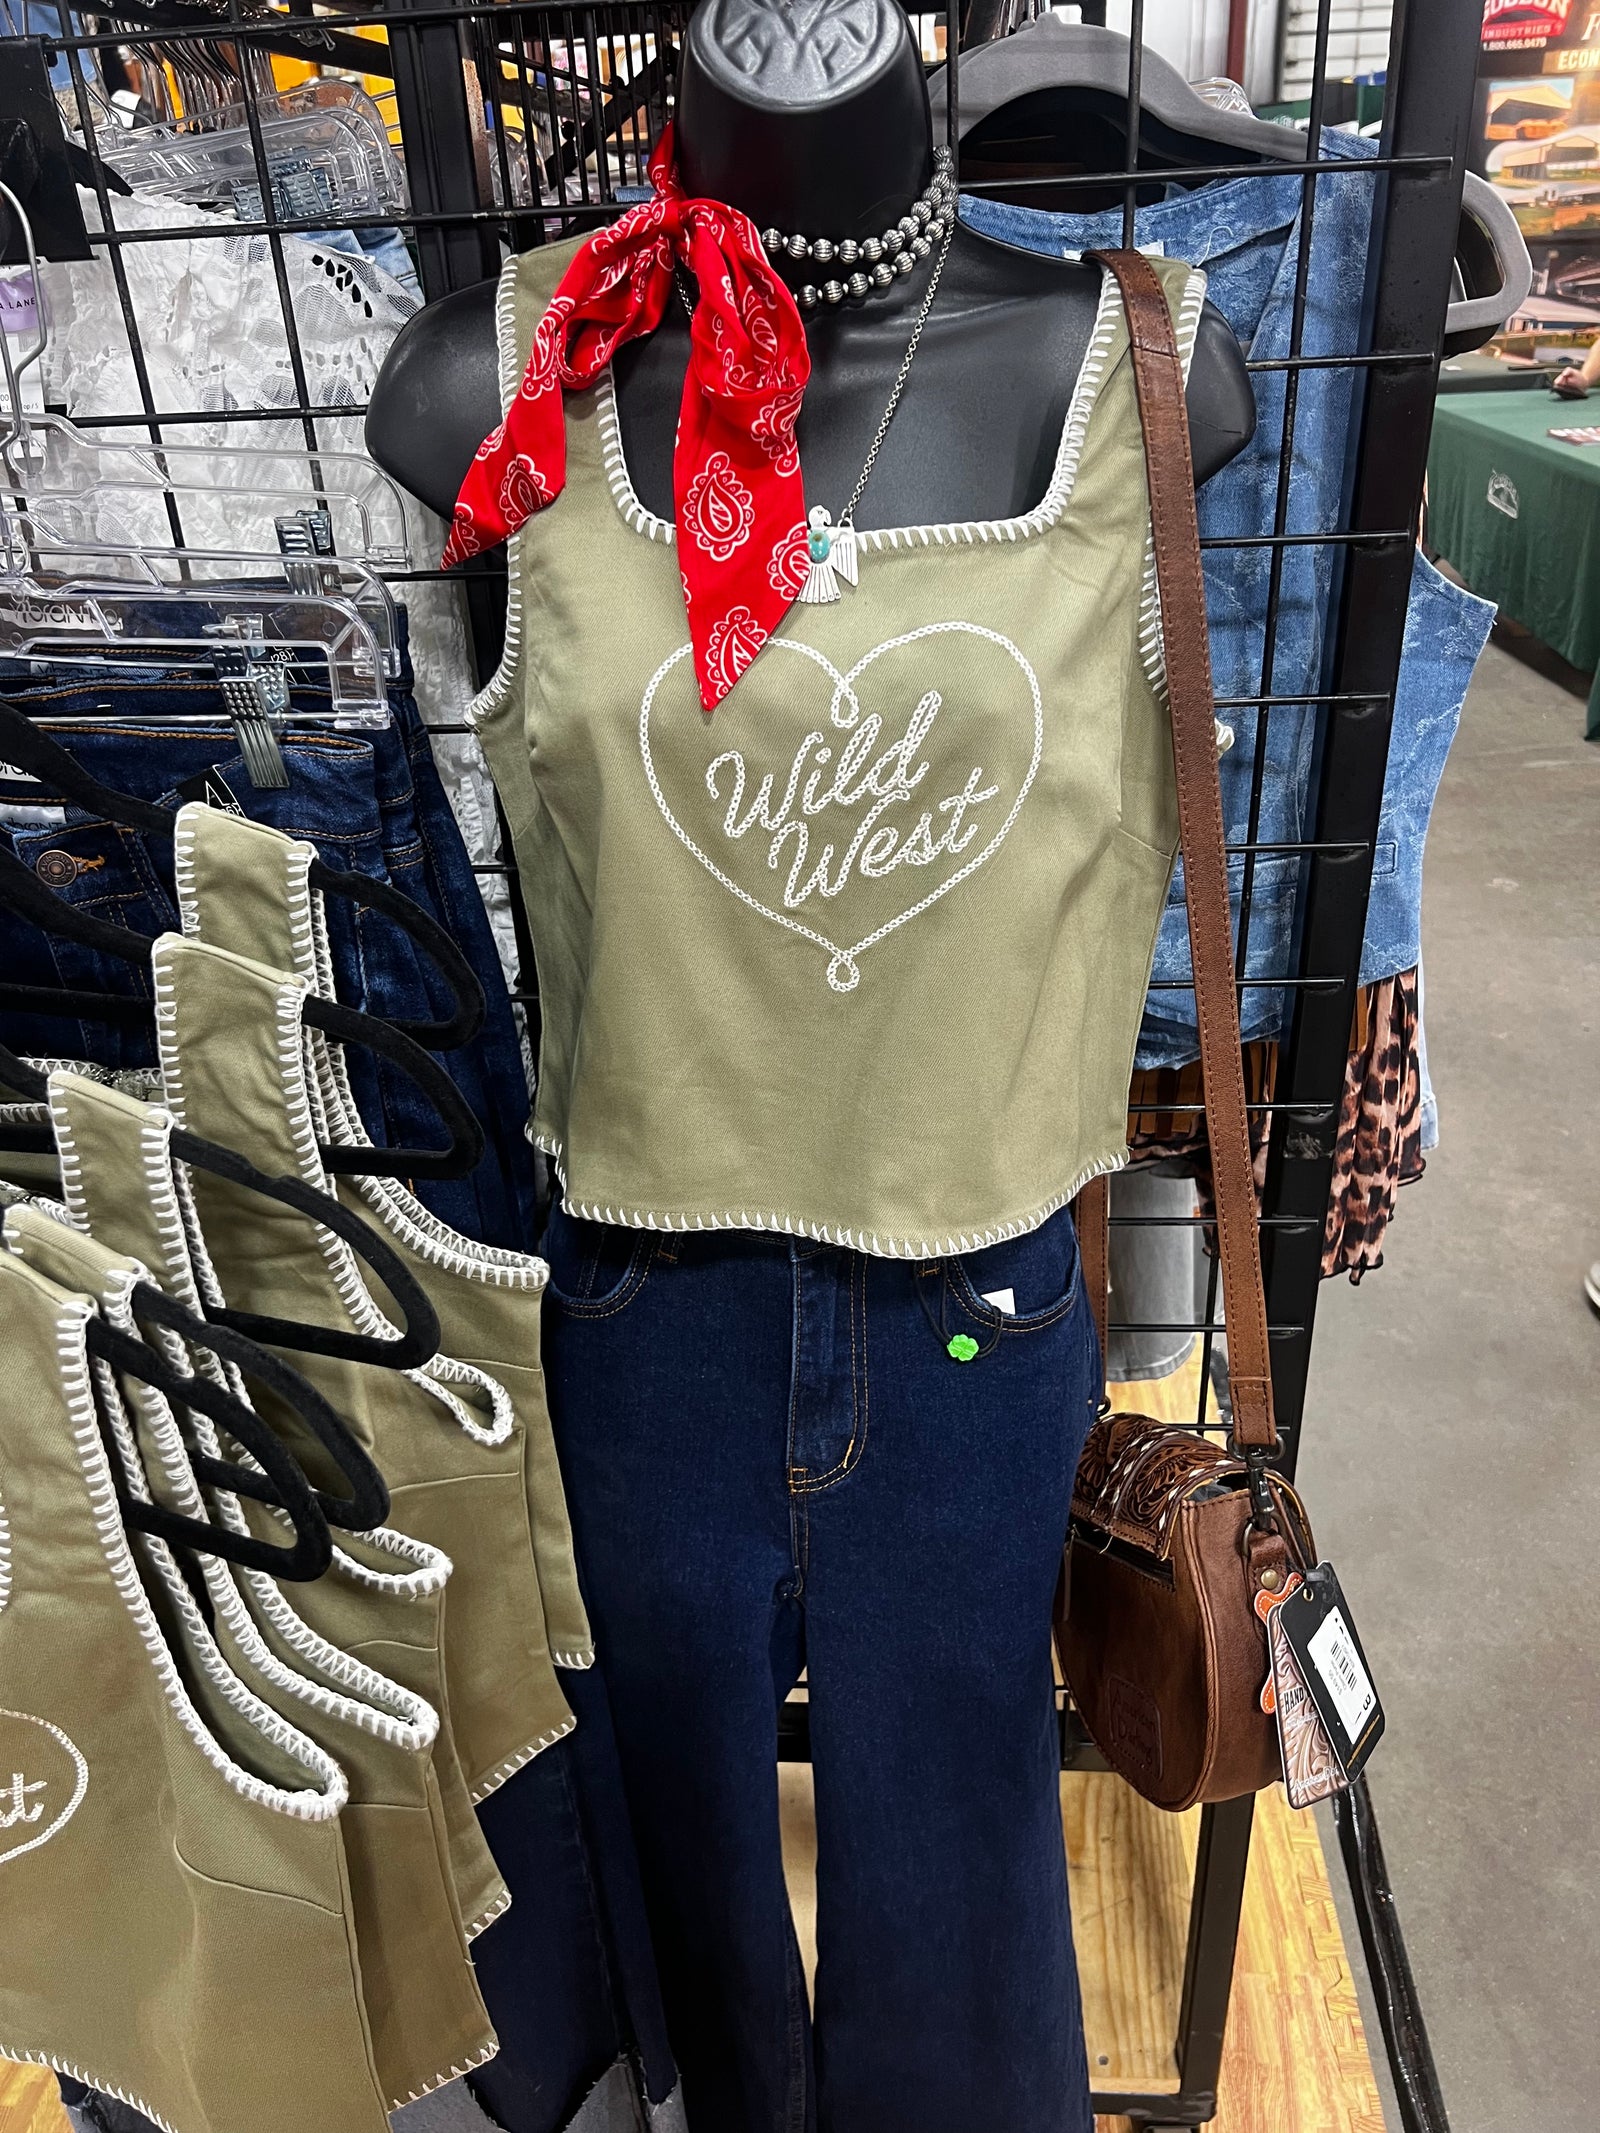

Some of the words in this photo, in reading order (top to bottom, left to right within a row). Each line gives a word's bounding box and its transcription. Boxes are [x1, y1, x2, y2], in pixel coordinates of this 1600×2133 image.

[9, 297, 36, 309] LANE
[706, 690, 942, 837] Wild
[767, 766, 999, 907] West
[0, 1772, 48, 1828] t
